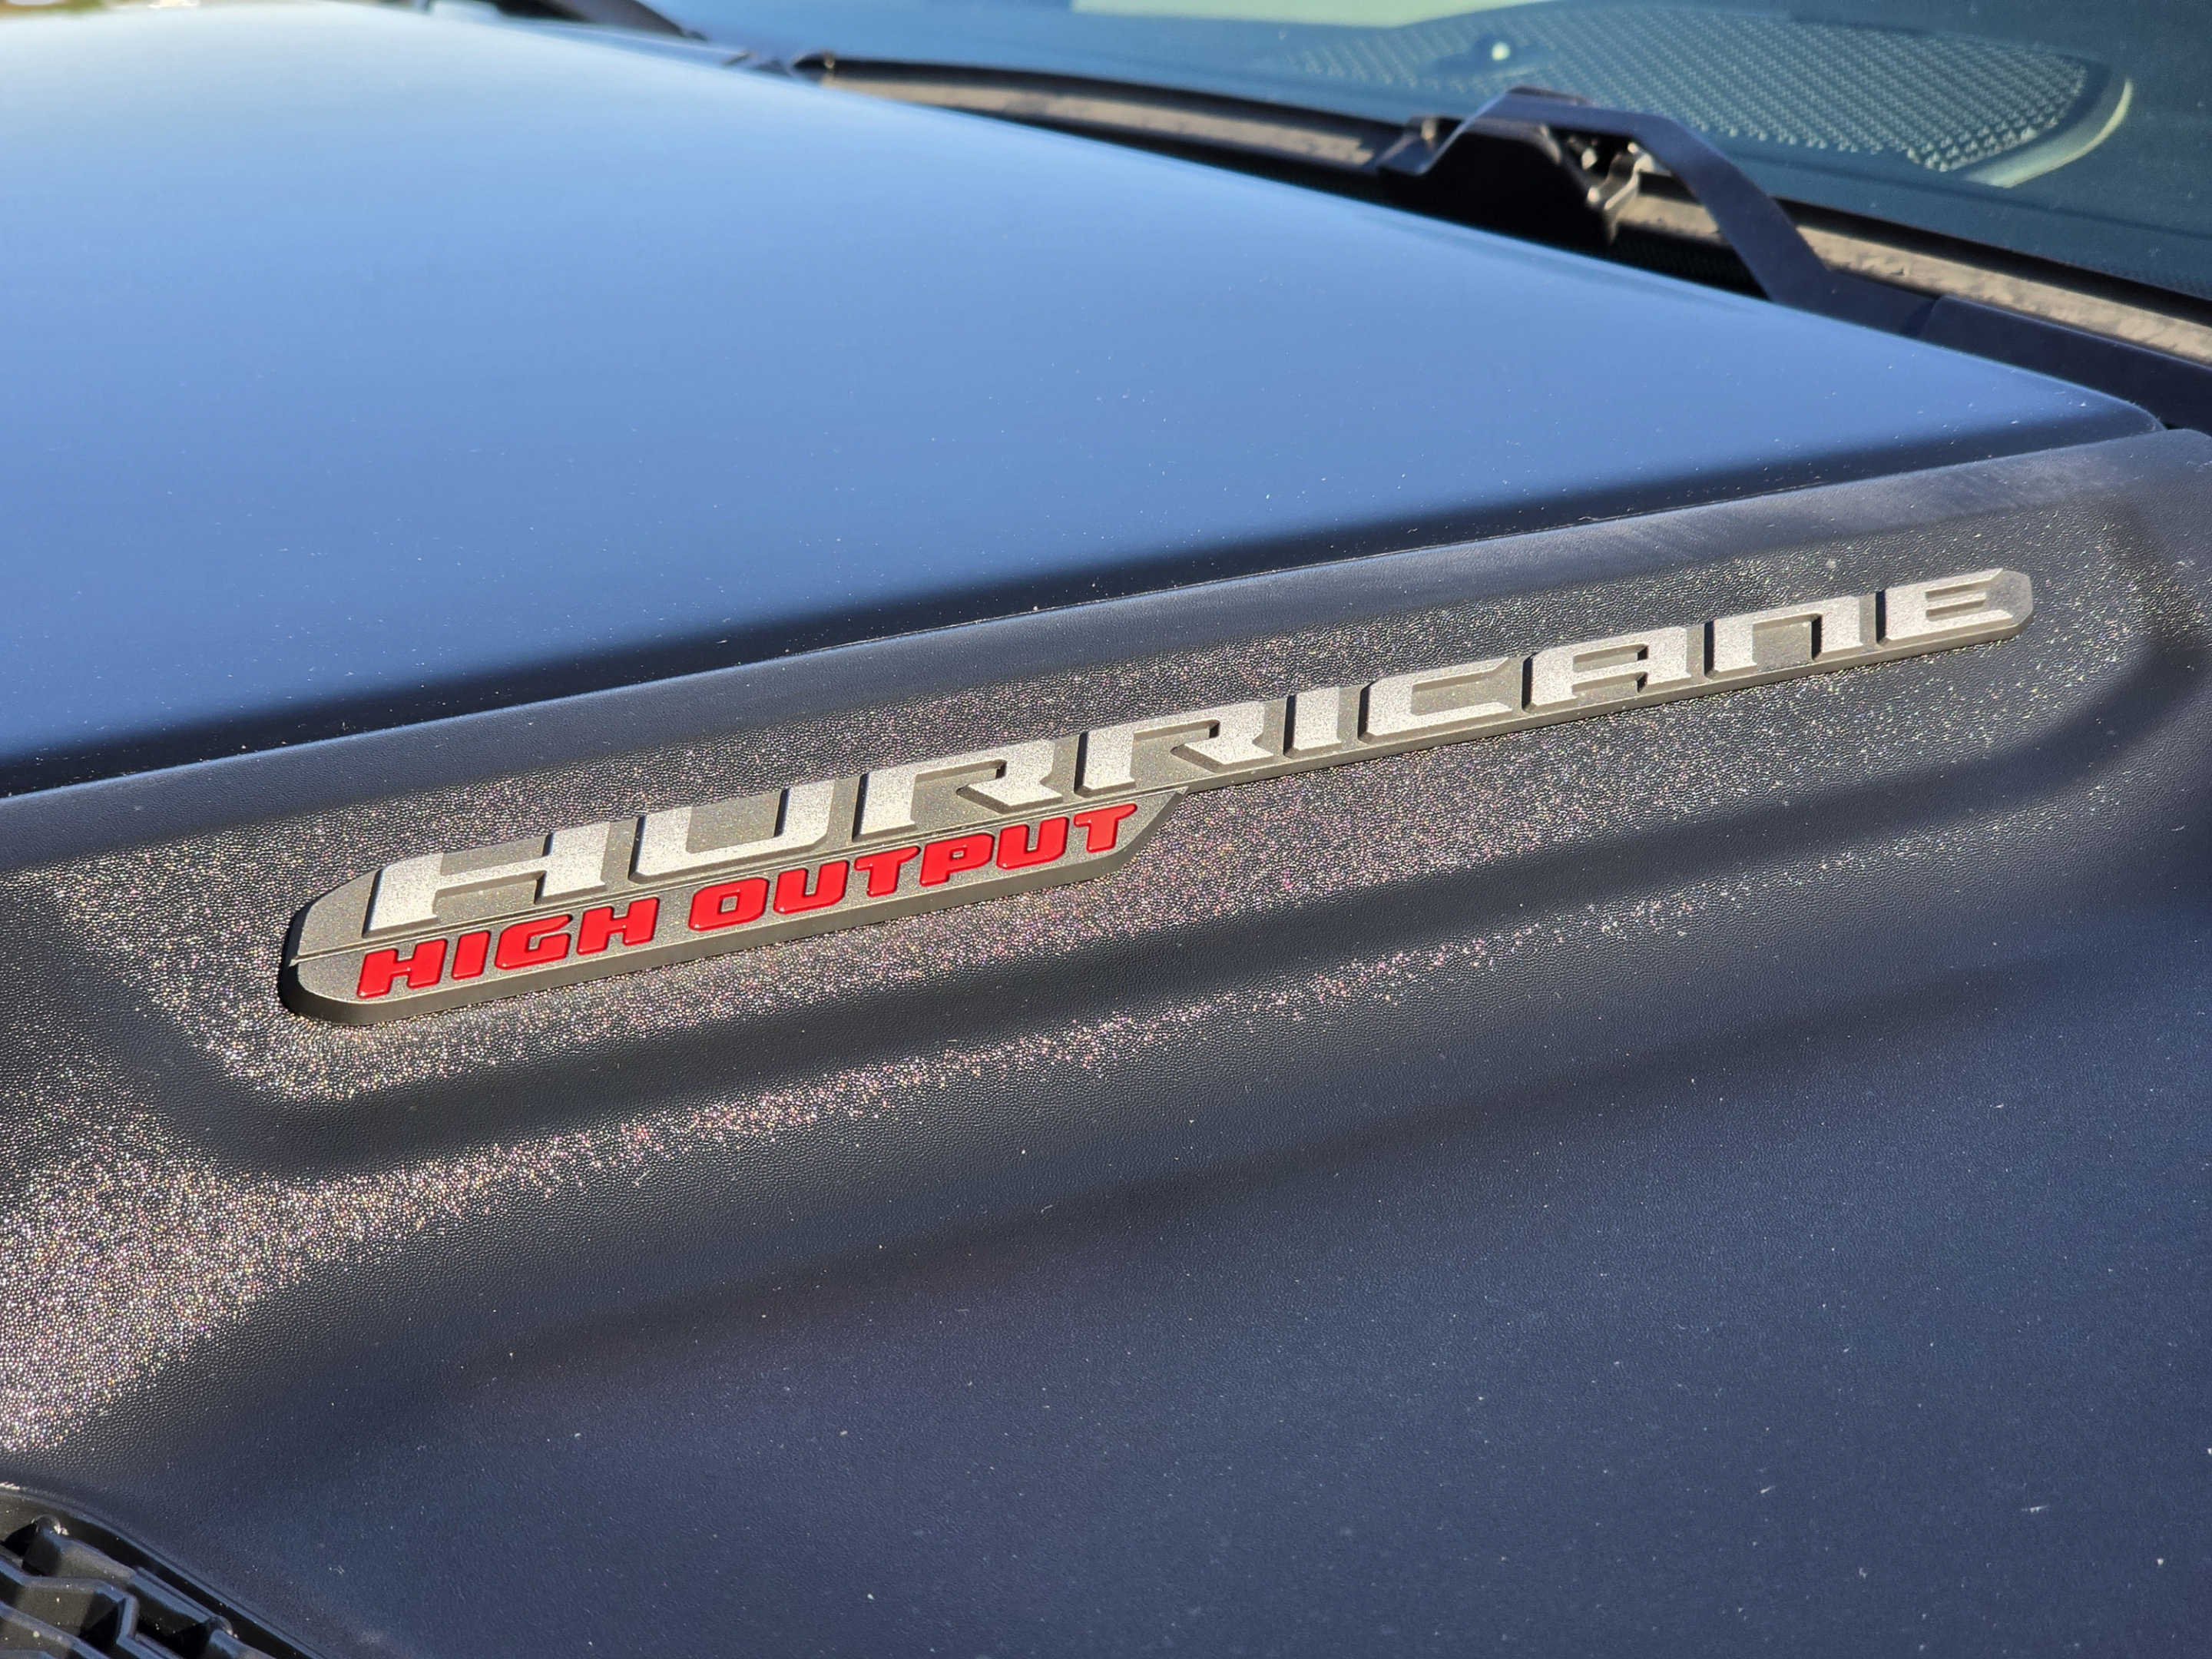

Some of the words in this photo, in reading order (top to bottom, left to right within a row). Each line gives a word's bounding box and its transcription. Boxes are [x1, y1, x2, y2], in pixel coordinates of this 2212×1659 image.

[364, 567, 2017, 935] HURRICANE
[355, 896, 660, 1001] HIGH
[687, 803, 1137, 933] OUTPUT
